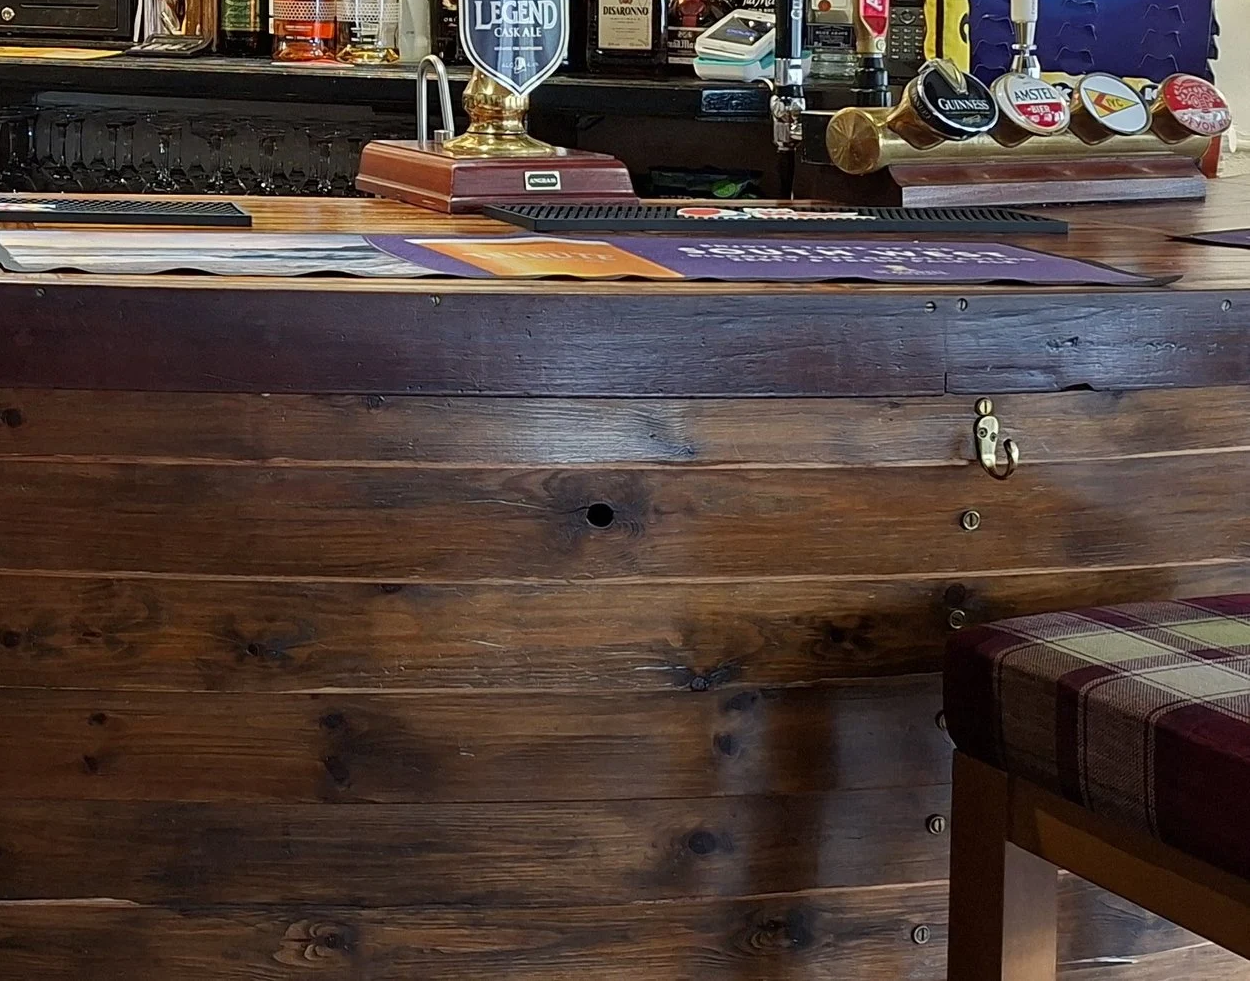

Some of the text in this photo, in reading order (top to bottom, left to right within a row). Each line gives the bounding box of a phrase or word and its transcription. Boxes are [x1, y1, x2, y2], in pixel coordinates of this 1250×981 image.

[474, 0, 558, 30] LEGEND
[602, 6, 649, 16] DISARONNO
[493, 27, 542, 37] CASK ALE
[1015, 88, 1057, 102] AMSTEL
[937, 98, 990, 111] GUINNESS
[1031, 105, 1050, 113] BIER
[1106, 98, 1124, 110] IYC
[528, 175, 558, 185] ANGRAM
[677, 246, 1010, 258] SOUTH WEST
